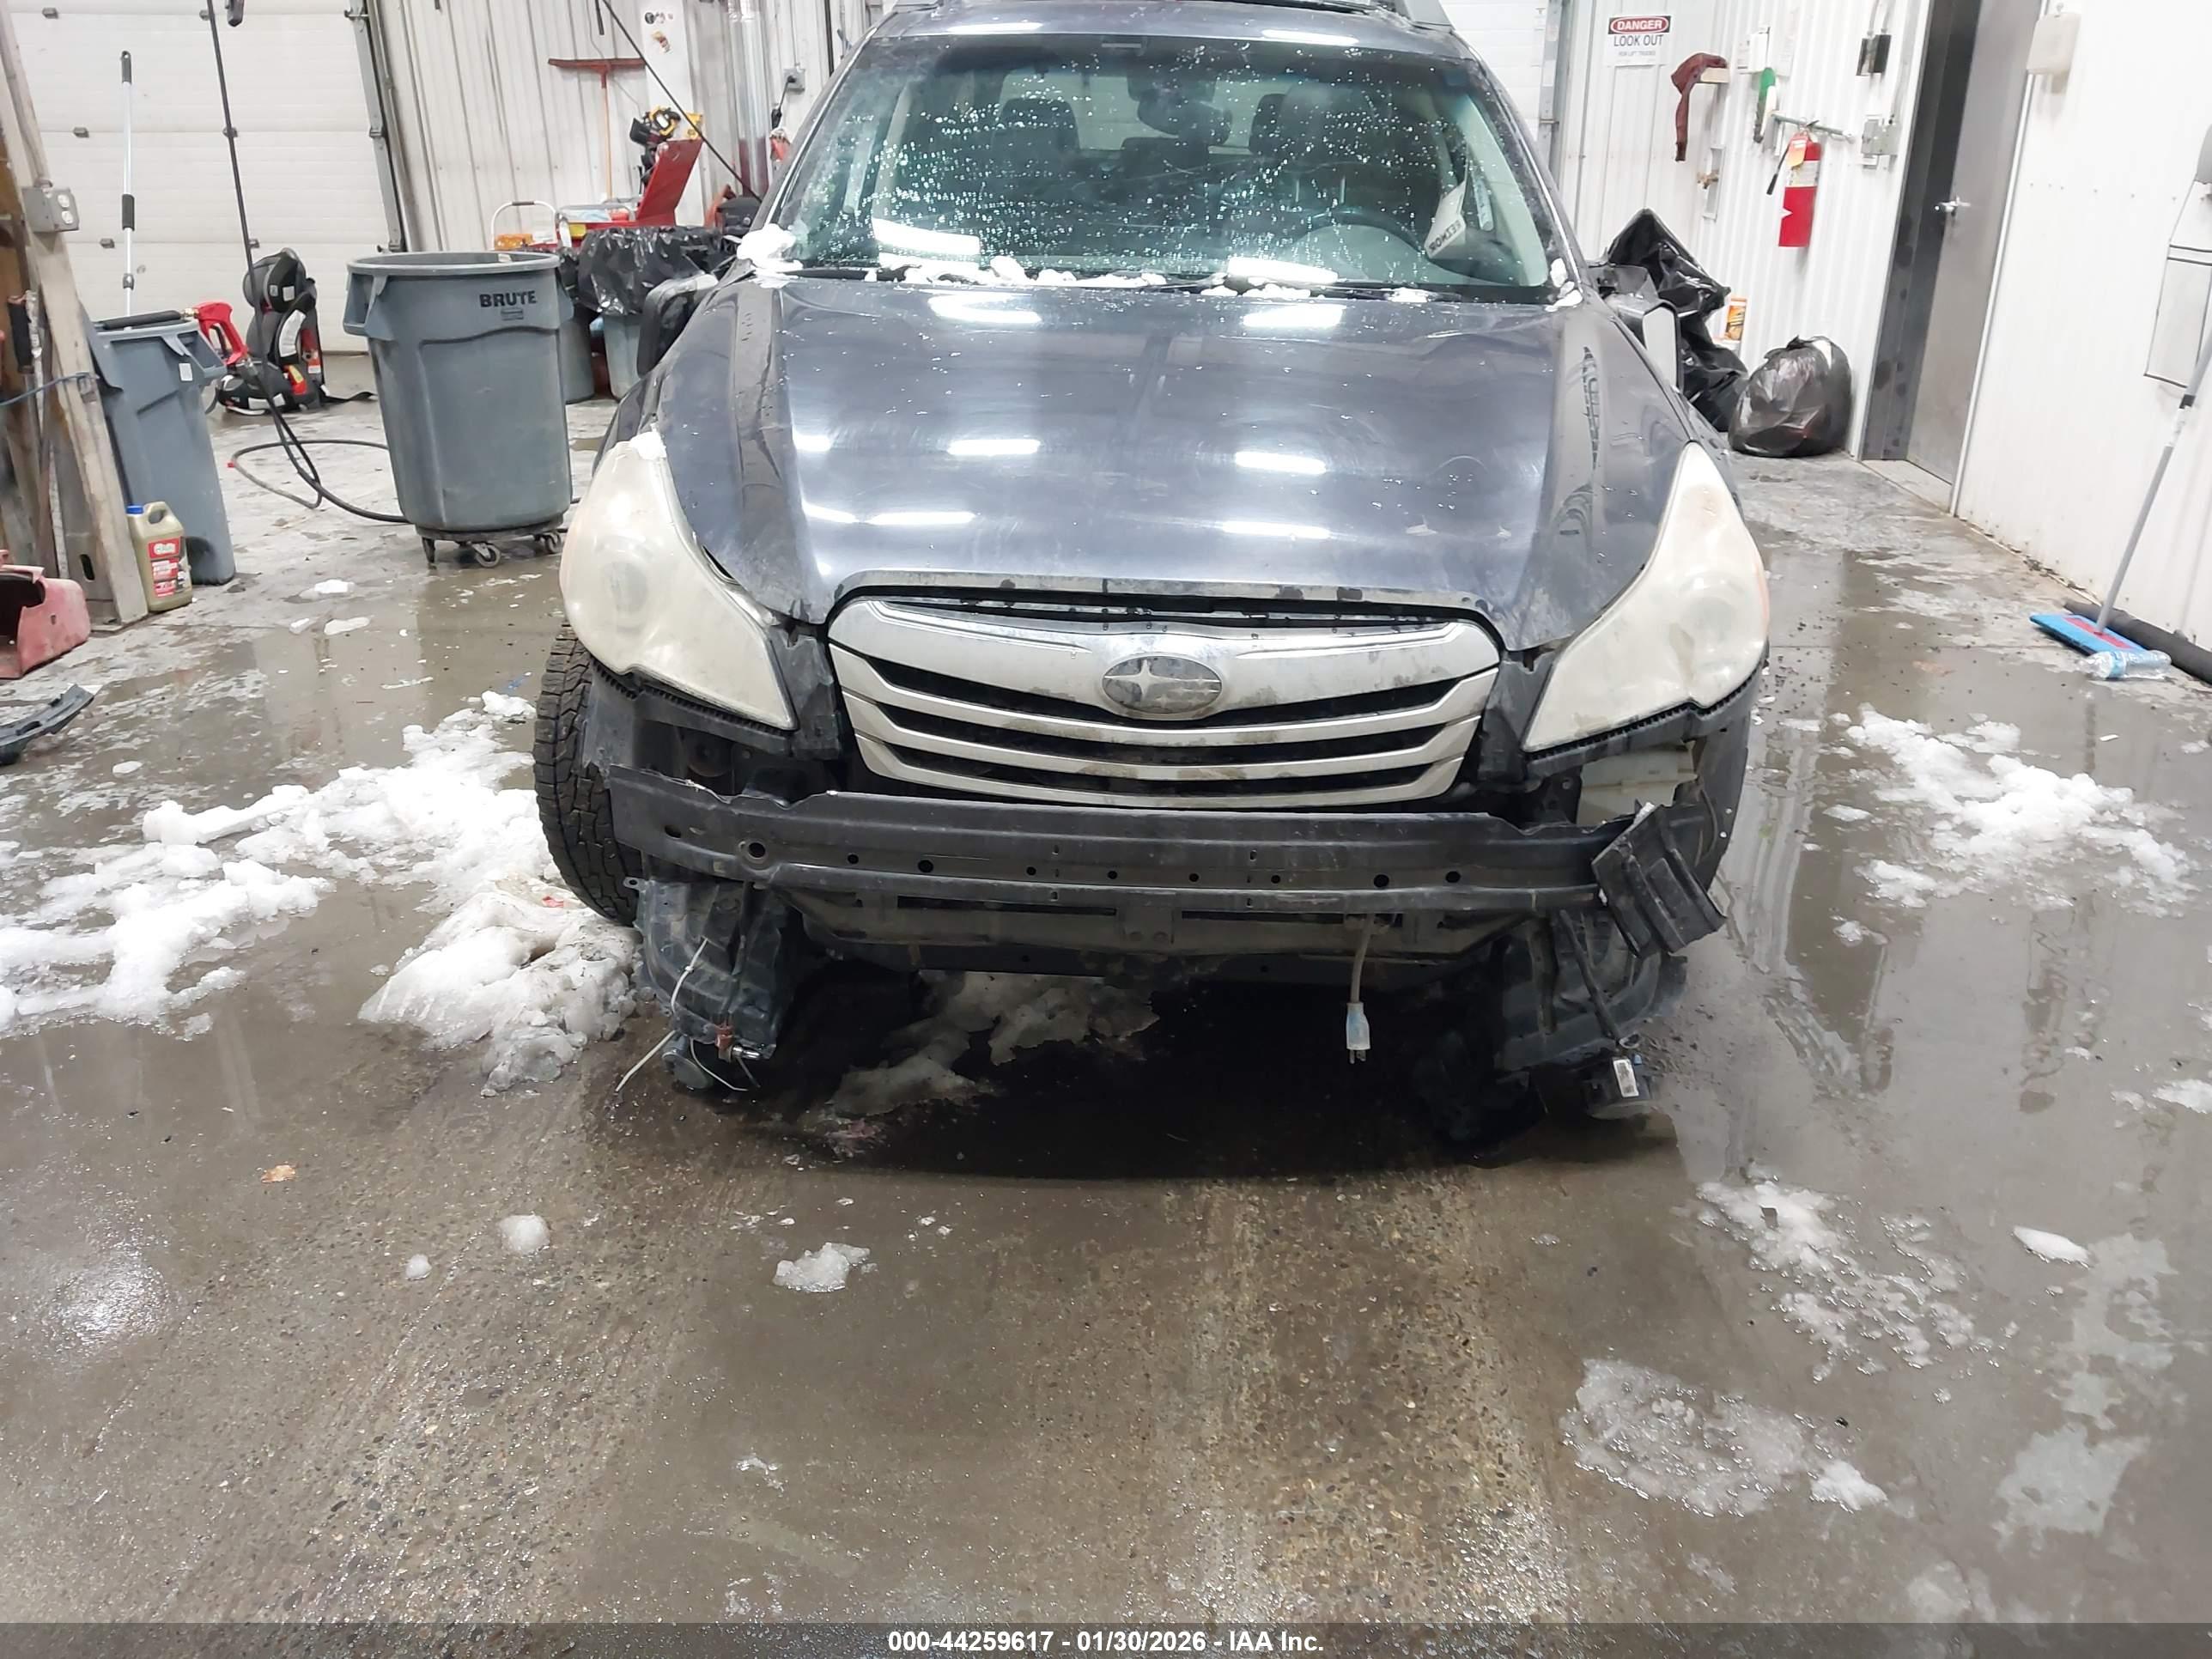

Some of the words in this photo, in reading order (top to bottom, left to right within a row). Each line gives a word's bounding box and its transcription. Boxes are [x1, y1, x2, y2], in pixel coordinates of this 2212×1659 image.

[1616, 20, 1663, 31] DANGER
[1613, 35, 1641, 46] LOOK
[1643, 34, 1664, 46] OUT
[479, 290, 538, 308] BRUTE
